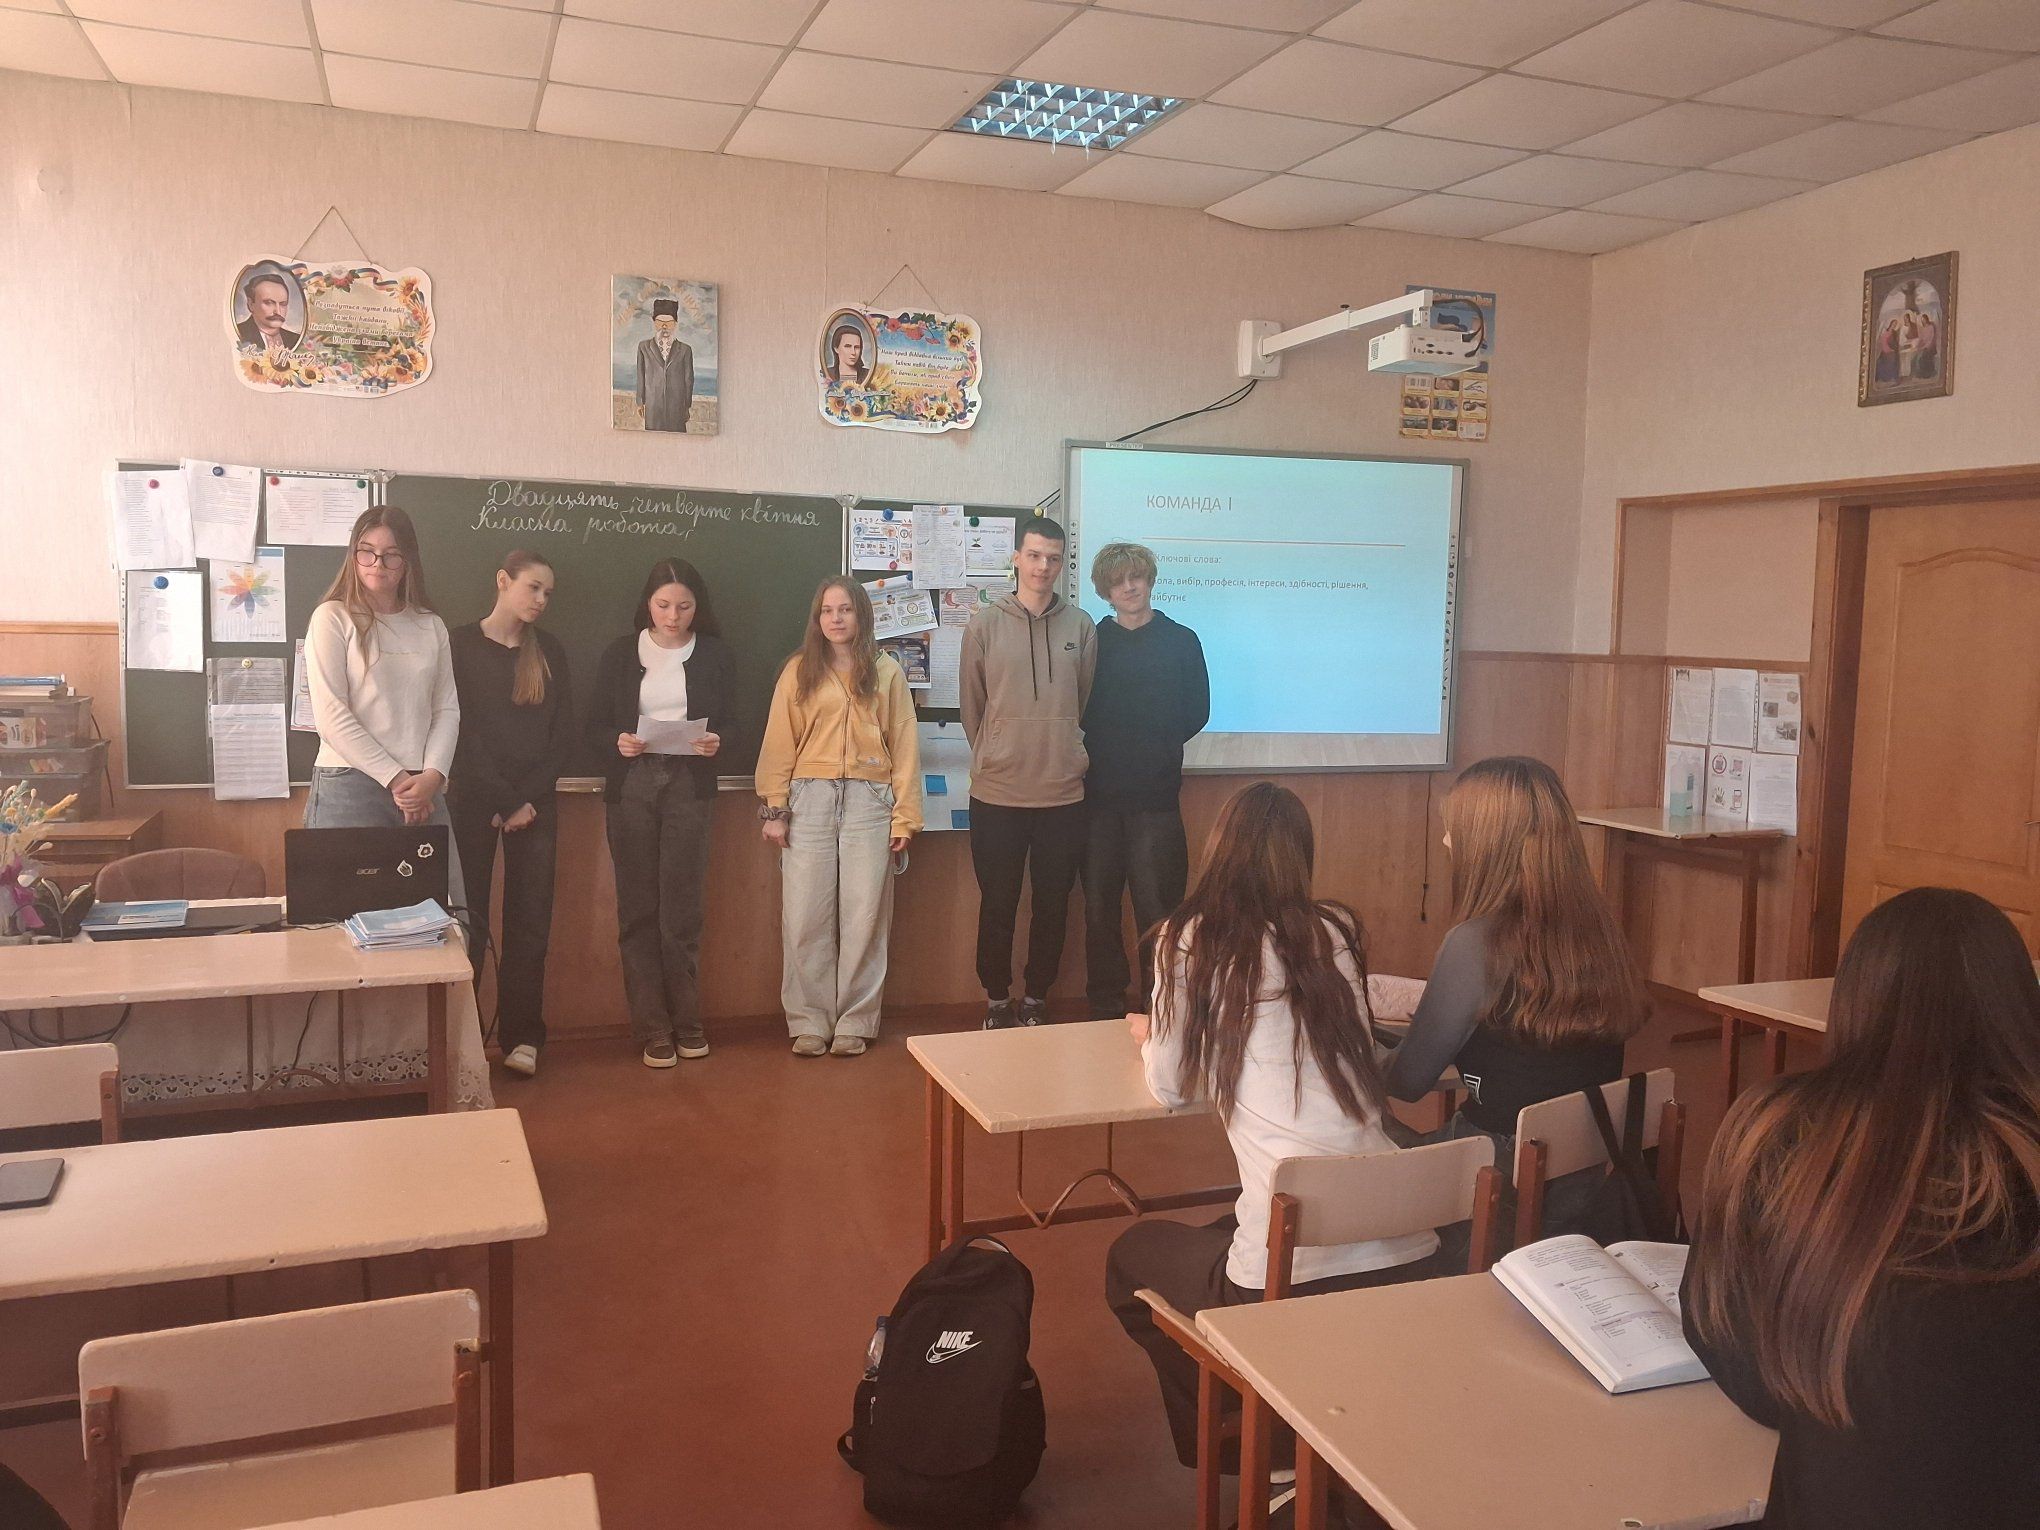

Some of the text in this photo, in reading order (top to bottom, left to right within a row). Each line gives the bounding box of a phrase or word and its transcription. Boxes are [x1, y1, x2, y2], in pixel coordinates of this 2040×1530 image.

[741, 497, 820, 527] квітня
[1147, 495, 1221, 513] КОМАНДА
[471, 505, 573, 533] Класна
[1194, 556, 1221, 564] слова:
[1177, 577, 1203, 587] вибір,
[1204, 578, 1246, 587] професія,
[1248, 580, 1287, 588] інтереси,
[1289, 580, 1329, 590] здібності,
[1331, 581, 1368, 590] рішення,
[936, 1331, 973, 1349] NIKE
